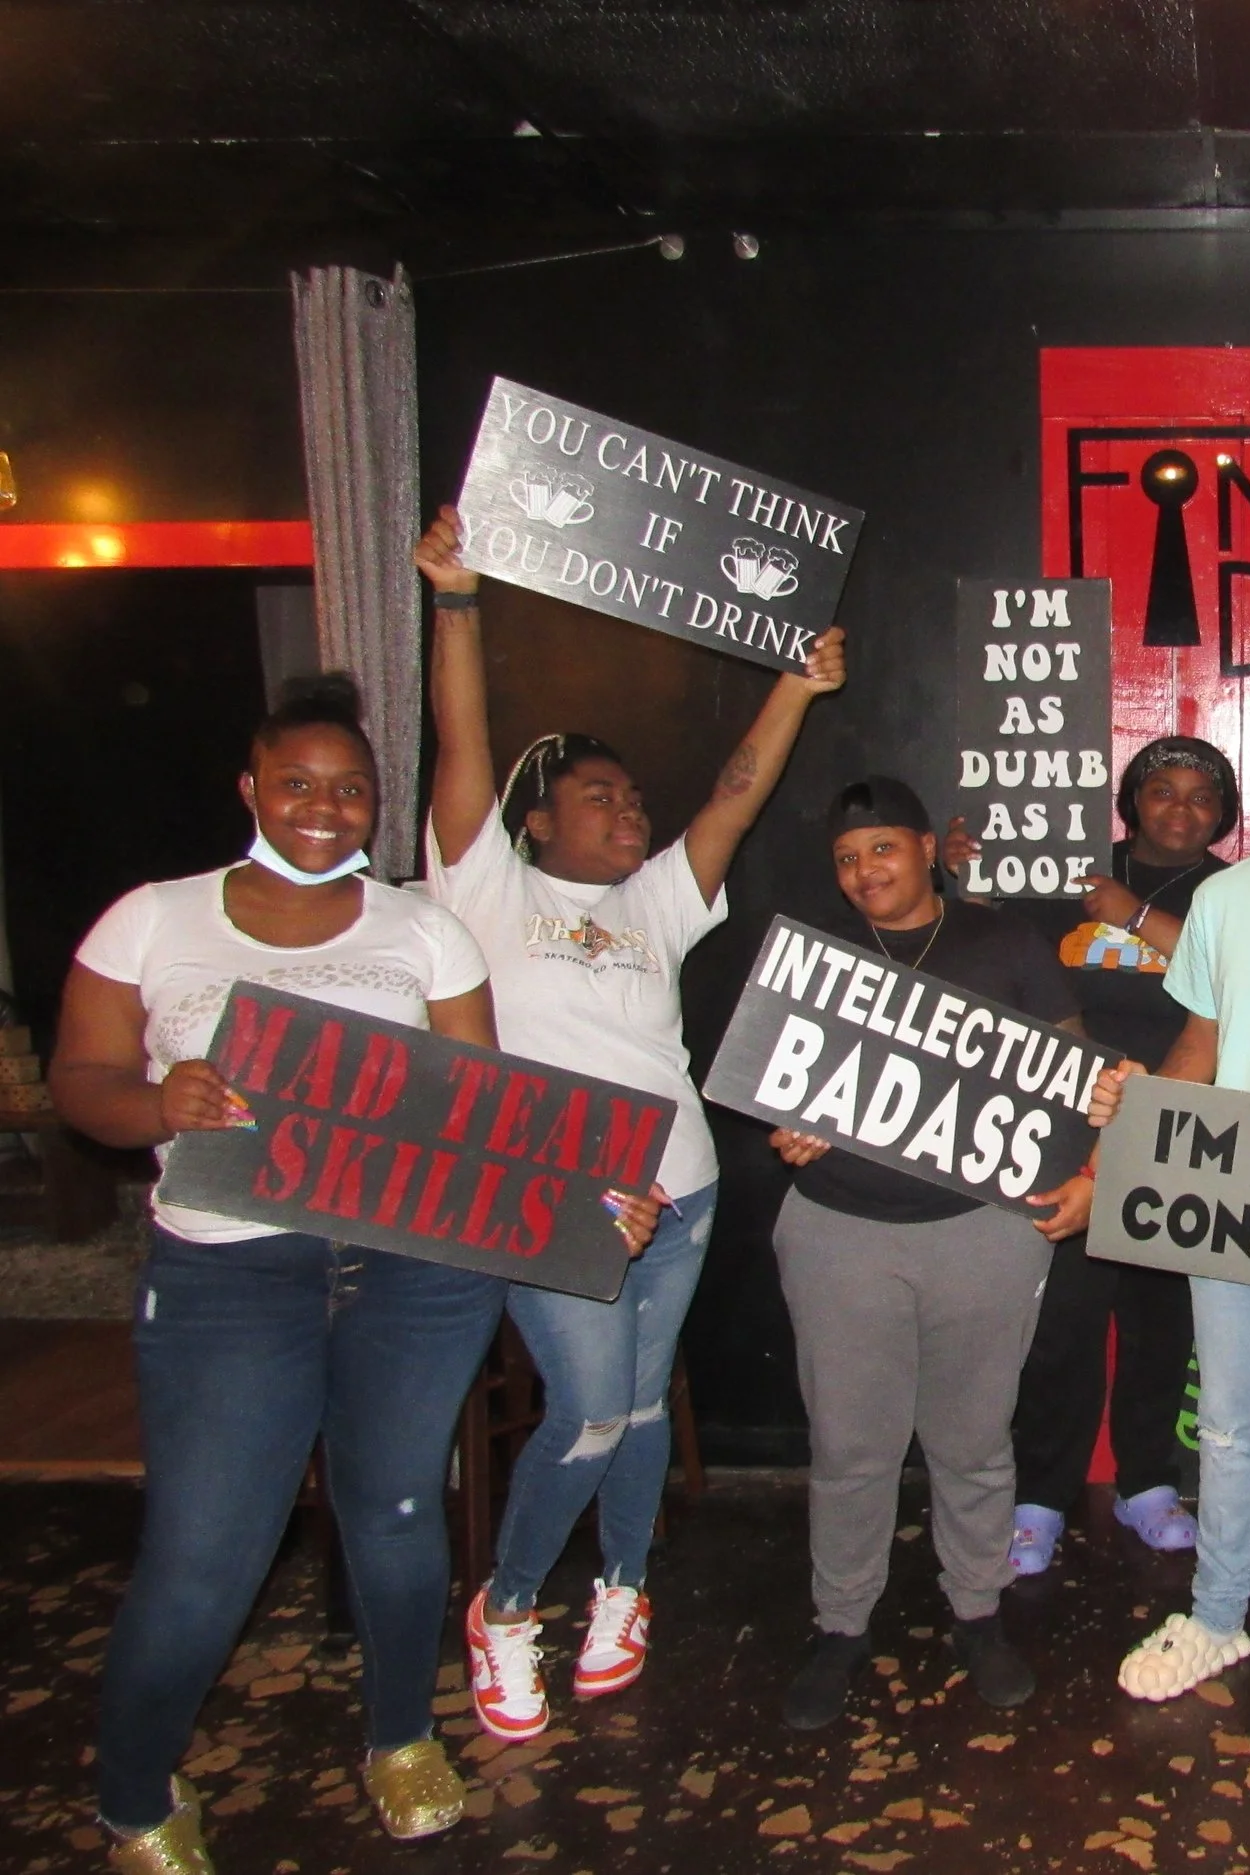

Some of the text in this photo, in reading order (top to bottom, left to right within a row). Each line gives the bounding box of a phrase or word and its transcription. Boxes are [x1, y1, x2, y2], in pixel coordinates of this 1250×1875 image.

[499, 394, 851, 555] YOU CAN'T THINK
[639, 512, 683, 554] IF
[462, 513, 817, 665] YOU DON'T DRINK
[992, 589, 1071, 627] I'M
[984, 643, 1081, 681] NOT
[1000, 696, 1064, 734] AS
[960, 751, 1107, 787] DUMB
[982, 803, 1086, 841] AS I
[967, 856, 1096, 893] LOOK
[216, 996, 662, 1187] MAD TEAM
[754, 1014, 1051, 1198] BADASS
[1154, 1108, 1239, 1175] I'M
[251, 1112, 567, 1258] SKILLS
